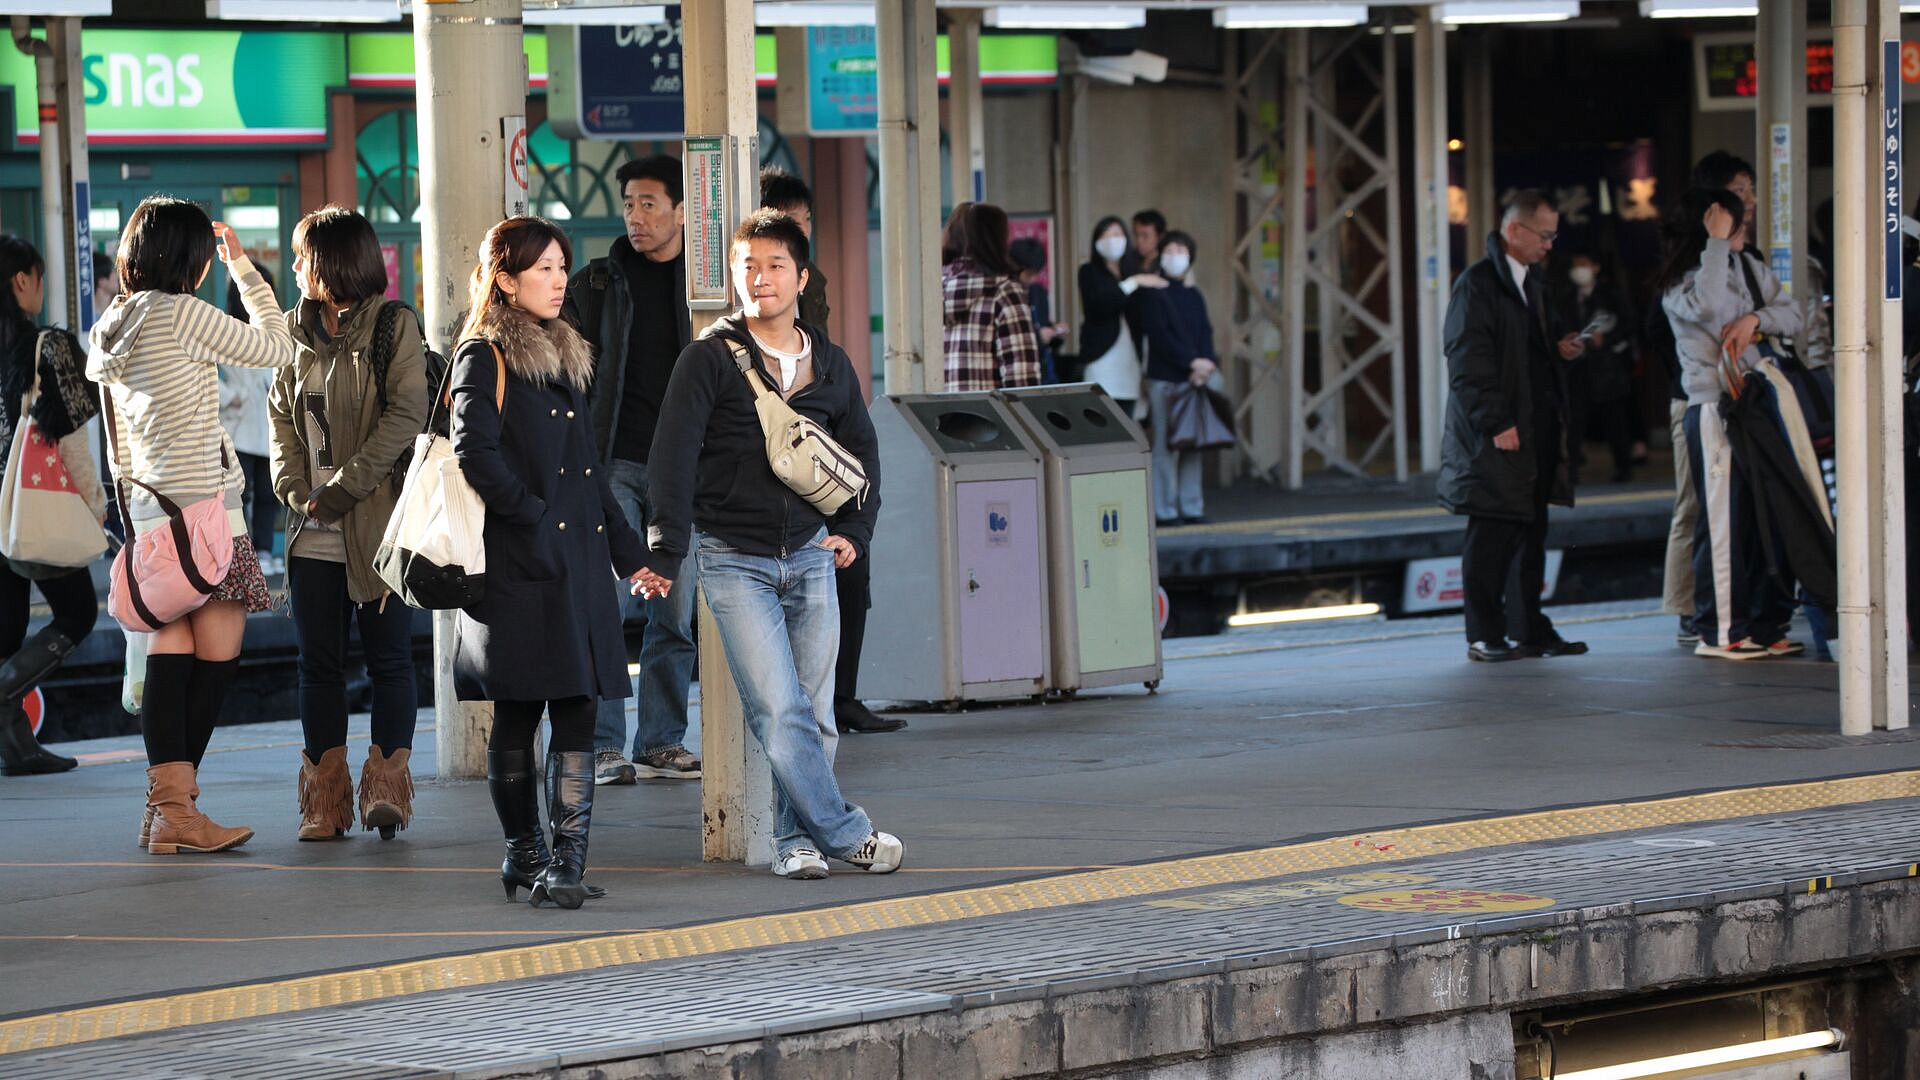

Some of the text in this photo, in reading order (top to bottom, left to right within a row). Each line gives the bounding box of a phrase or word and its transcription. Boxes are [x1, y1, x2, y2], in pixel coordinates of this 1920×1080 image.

[1903, 47, 1919, 77] 3
[1886, 108, 1898, 233] じゅうそう
[1448, 925, 1460, 939] 16
